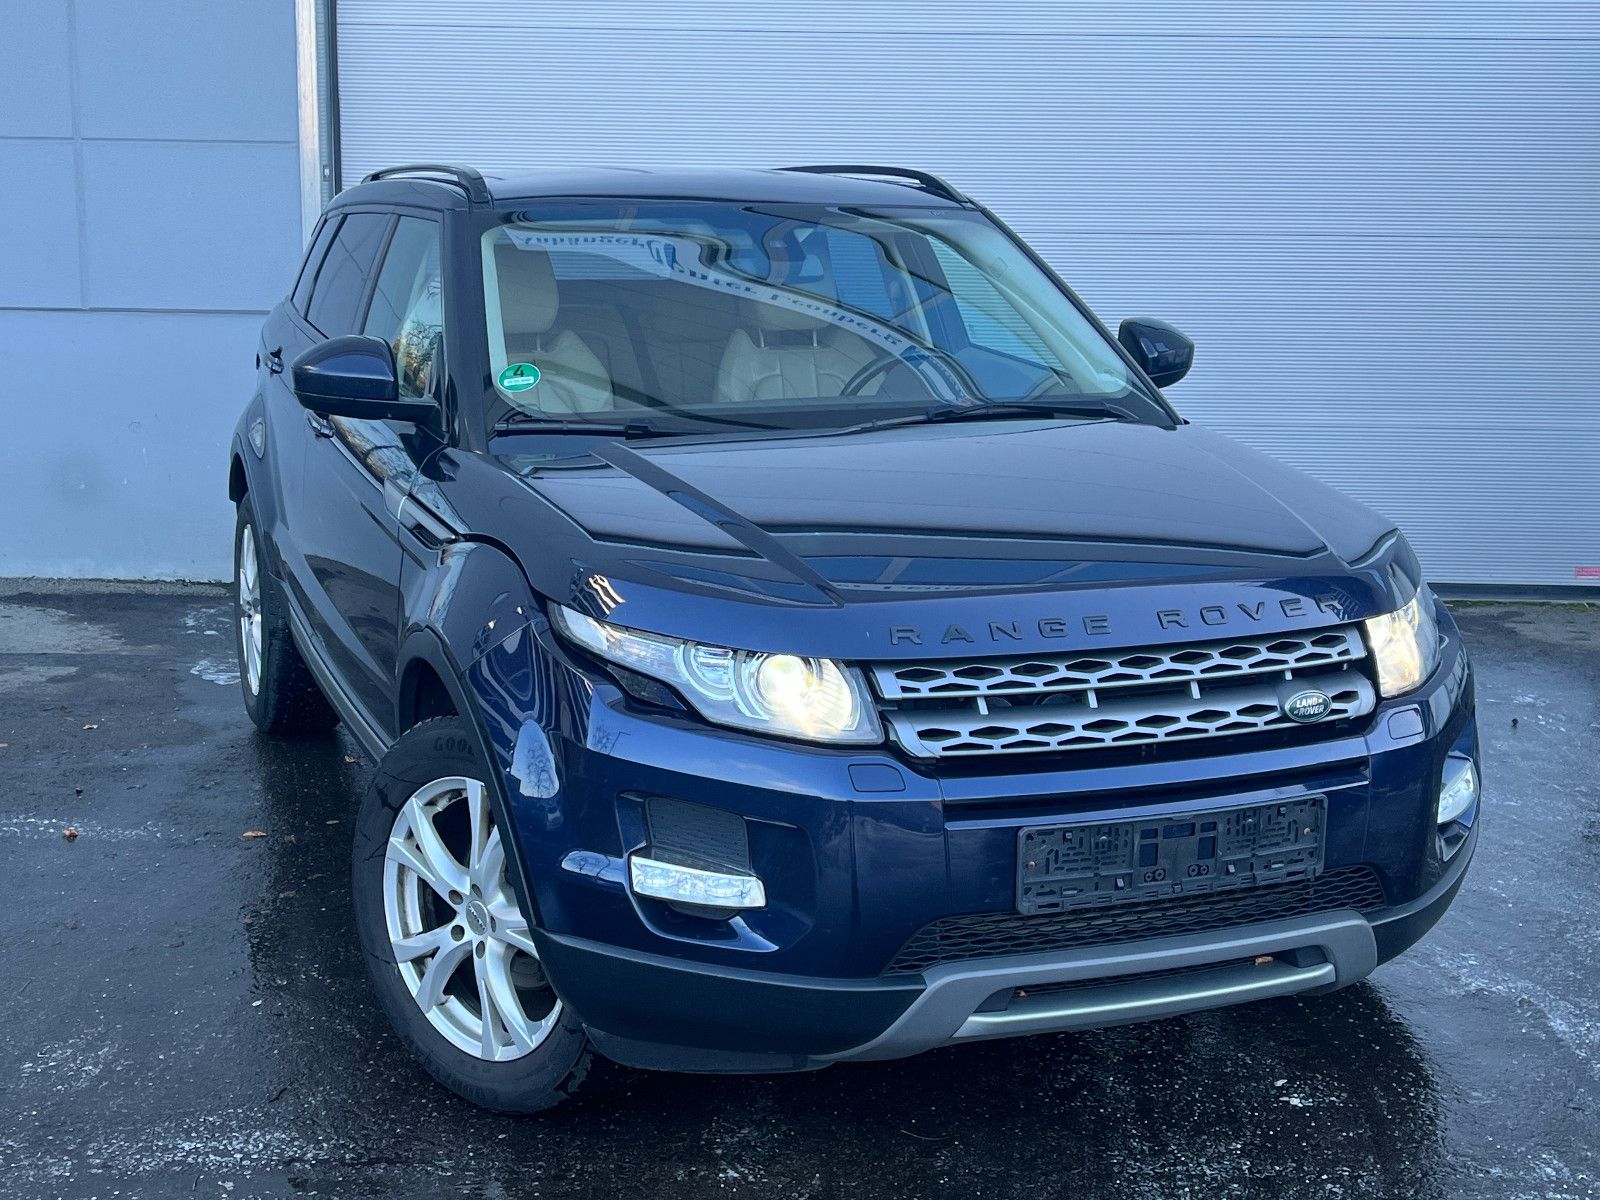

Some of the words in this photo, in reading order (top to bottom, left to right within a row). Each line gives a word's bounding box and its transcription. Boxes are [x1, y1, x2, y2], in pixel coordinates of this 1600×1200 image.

[513, 364, 525, 377] 4
[889, 614, 1113, 646] RANGE
[1156, 595, 1346, 630] ROVER
[1296, 697, 1318, 708] LAND
[1298, 704, 1325, 716] ROVER
